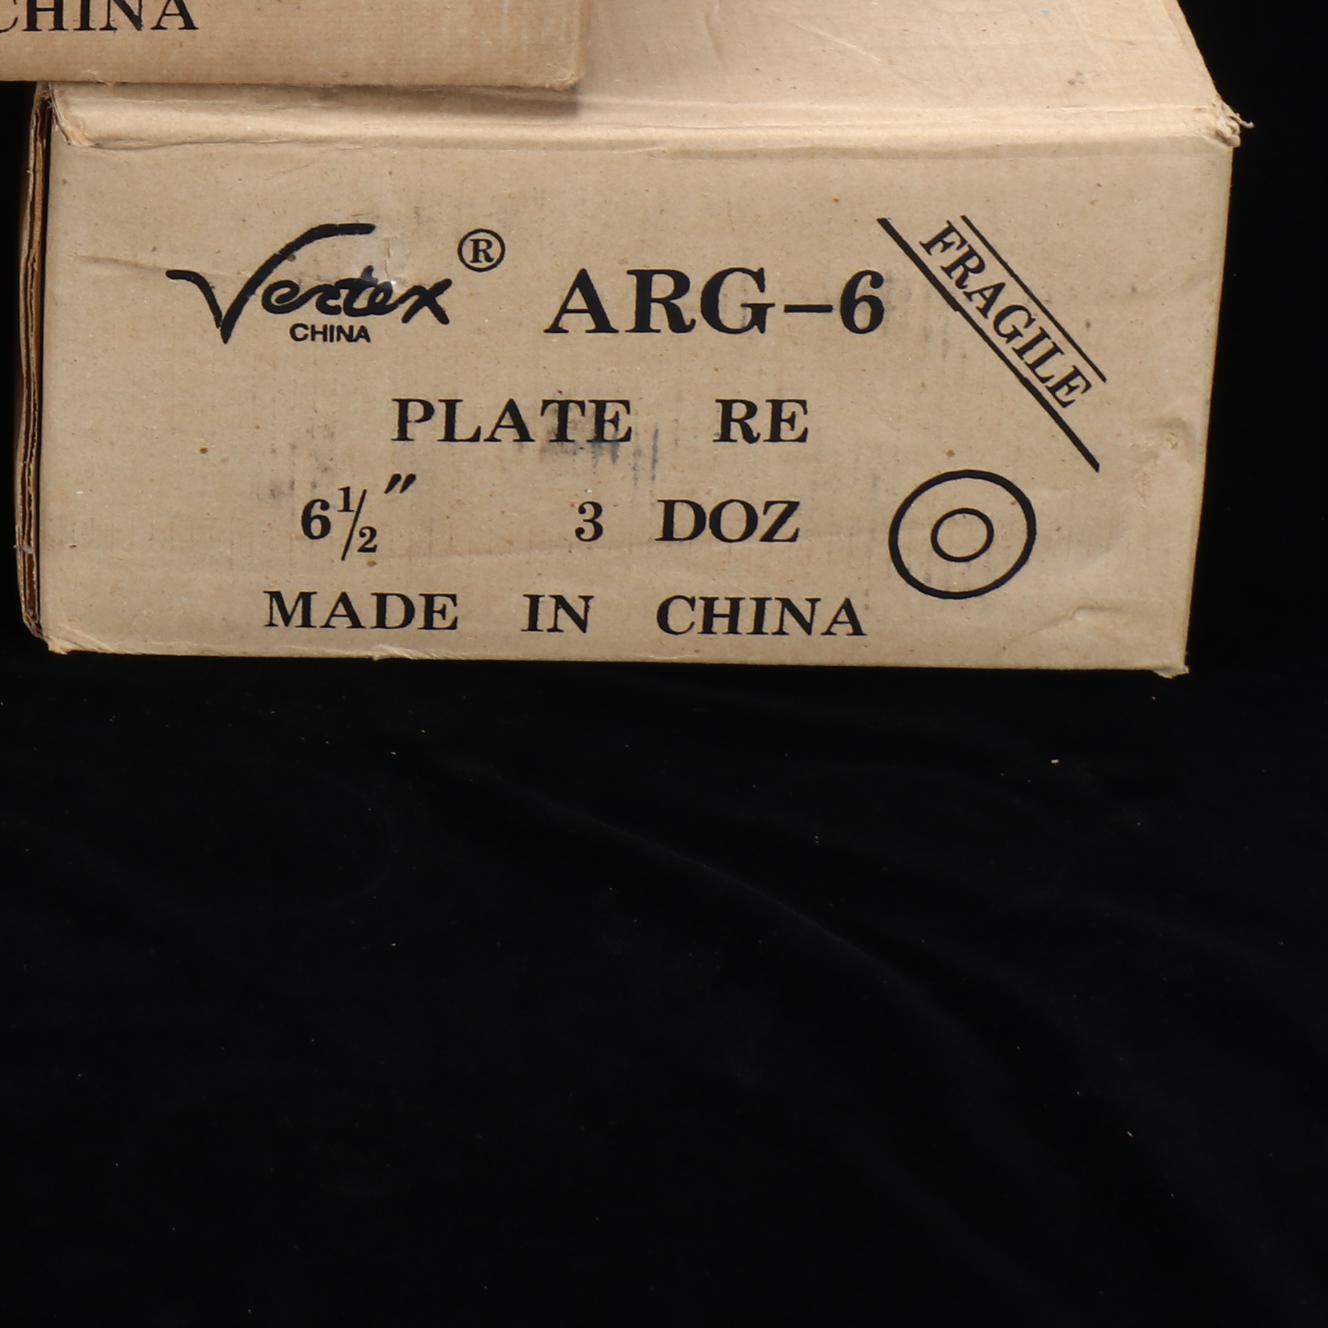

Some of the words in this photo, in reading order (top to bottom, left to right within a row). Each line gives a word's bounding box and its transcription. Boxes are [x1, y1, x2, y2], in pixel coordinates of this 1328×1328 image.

[164, 222, 453, 345] Vertex
[543, 267, 886, 335] ARG-6
[289, 322, 372, 344] CHINA
[919, 218, 1092, 409] FRAGILE
[391, 398, 633, 444] PLATE
[712, 398, 809, 445] RE
[574, 500, 604, 543] 3
[654, 498, 801, 544] DOZ
[263, 590, 459, 631] MADE
[520, 593, 595, 634] IN
[656, 594, 867, 637] CHINA
